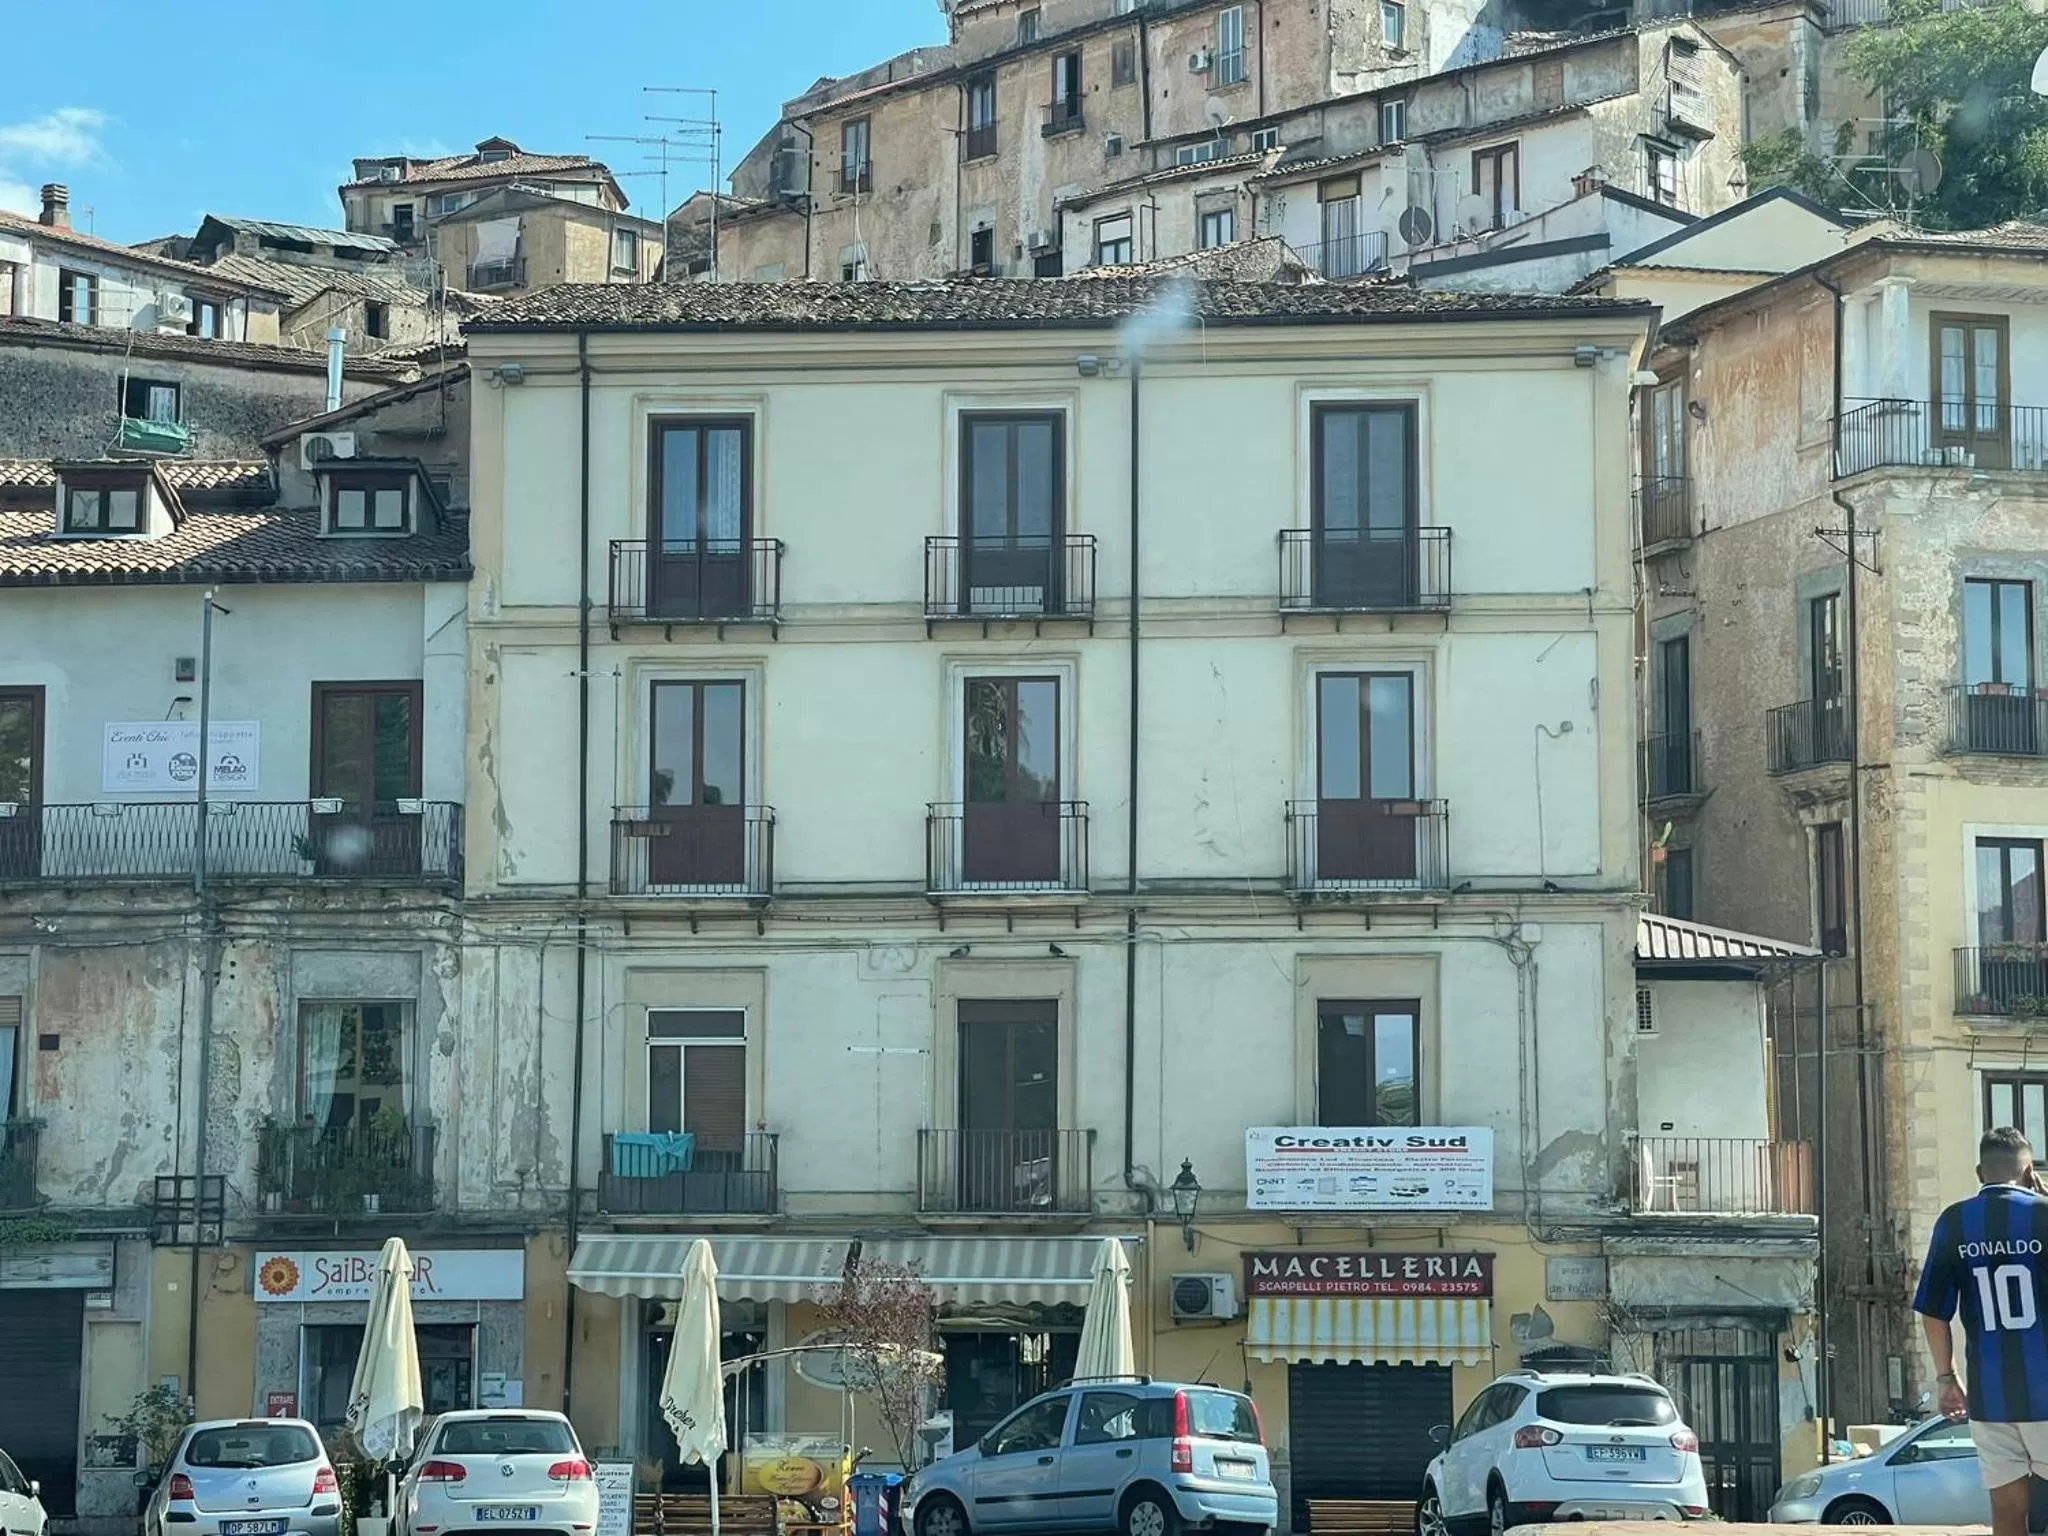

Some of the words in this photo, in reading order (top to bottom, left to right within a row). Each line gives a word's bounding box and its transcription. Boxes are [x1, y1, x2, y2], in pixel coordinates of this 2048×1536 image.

[1275, 1135, 1394, 1147] Creativ
[1407, 1135, 1467, 1147] Sud
[1253, 1256, 1483, 1278] MACELLERIA
[1258, 1281, 1321, 1291] SCARPELLI
[1326, 1282, 1370, 1291] PIETRO
[1441, 1282, 1479, 1291] 23575
[1973, 1264, 2037, 1332] 10
[482, 1509, 495, 1520] EL
